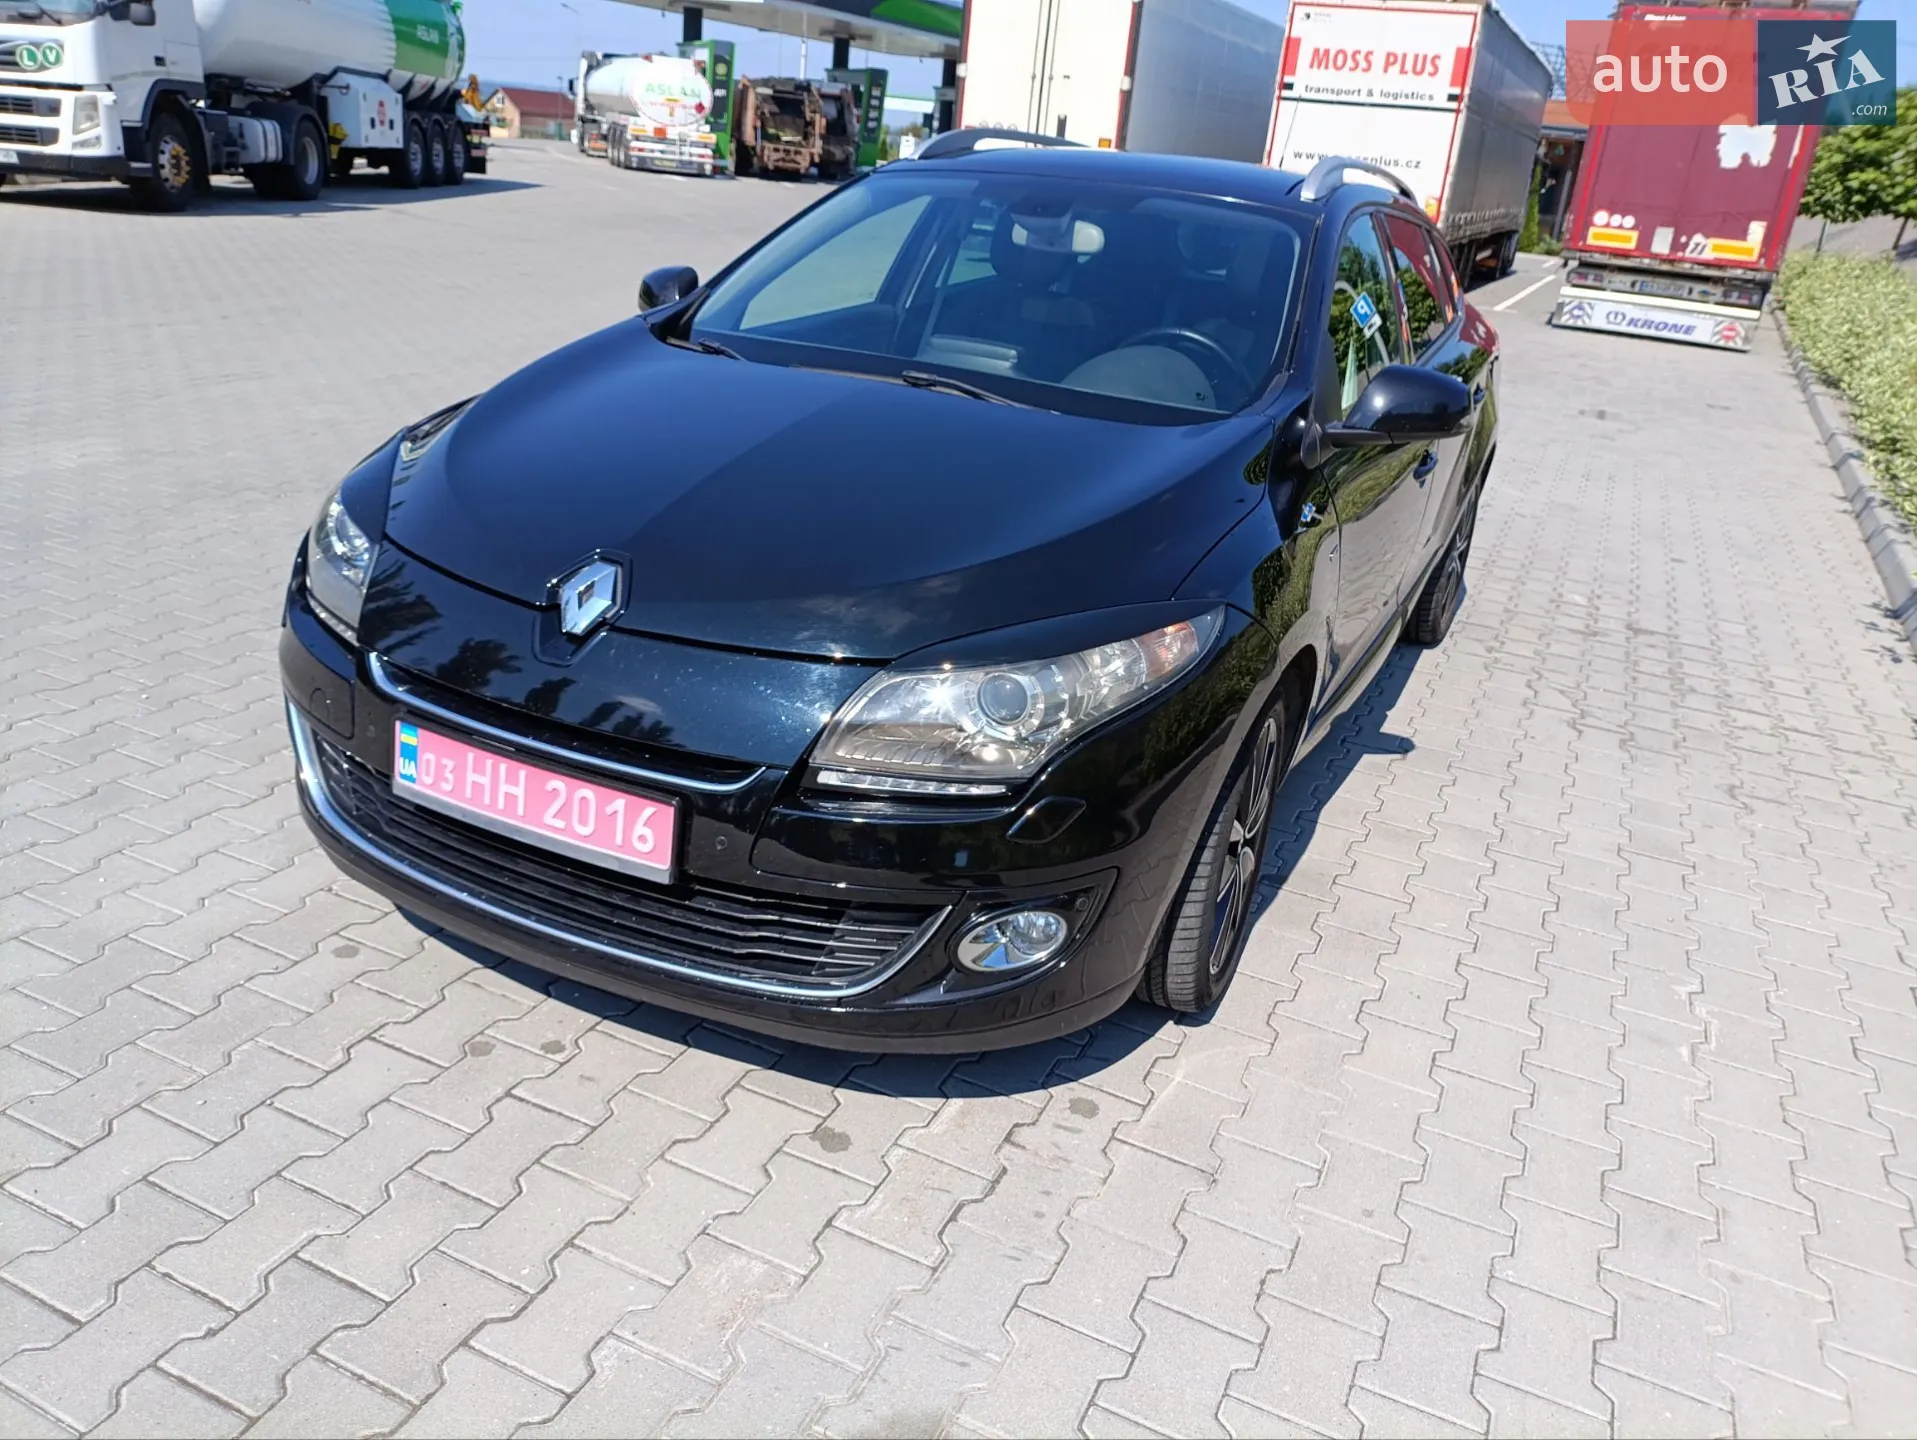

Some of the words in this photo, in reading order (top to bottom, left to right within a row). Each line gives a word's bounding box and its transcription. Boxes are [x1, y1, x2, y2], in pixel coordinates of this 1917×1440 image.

[23, 50, 34, 66] L
[45, 48, 58, 63] V
[1309, 47, 1374, 73] MOSS
[1383, 51, 1442, 77] PLUS
[645, 83, 701, 99] ASLAN
[1304, 84, 1362, 98] transport
[1366, 88, 1374, 98] &
[1380, 90, 1435, 101] logistics
[1626, 317, 1698, 336] KRONE
[398, 757, 418, 780] UA
[420, 752, 456, 792] 03
[466, 752, 527, 816] HH
[543, 779, 658, 854] 2016
